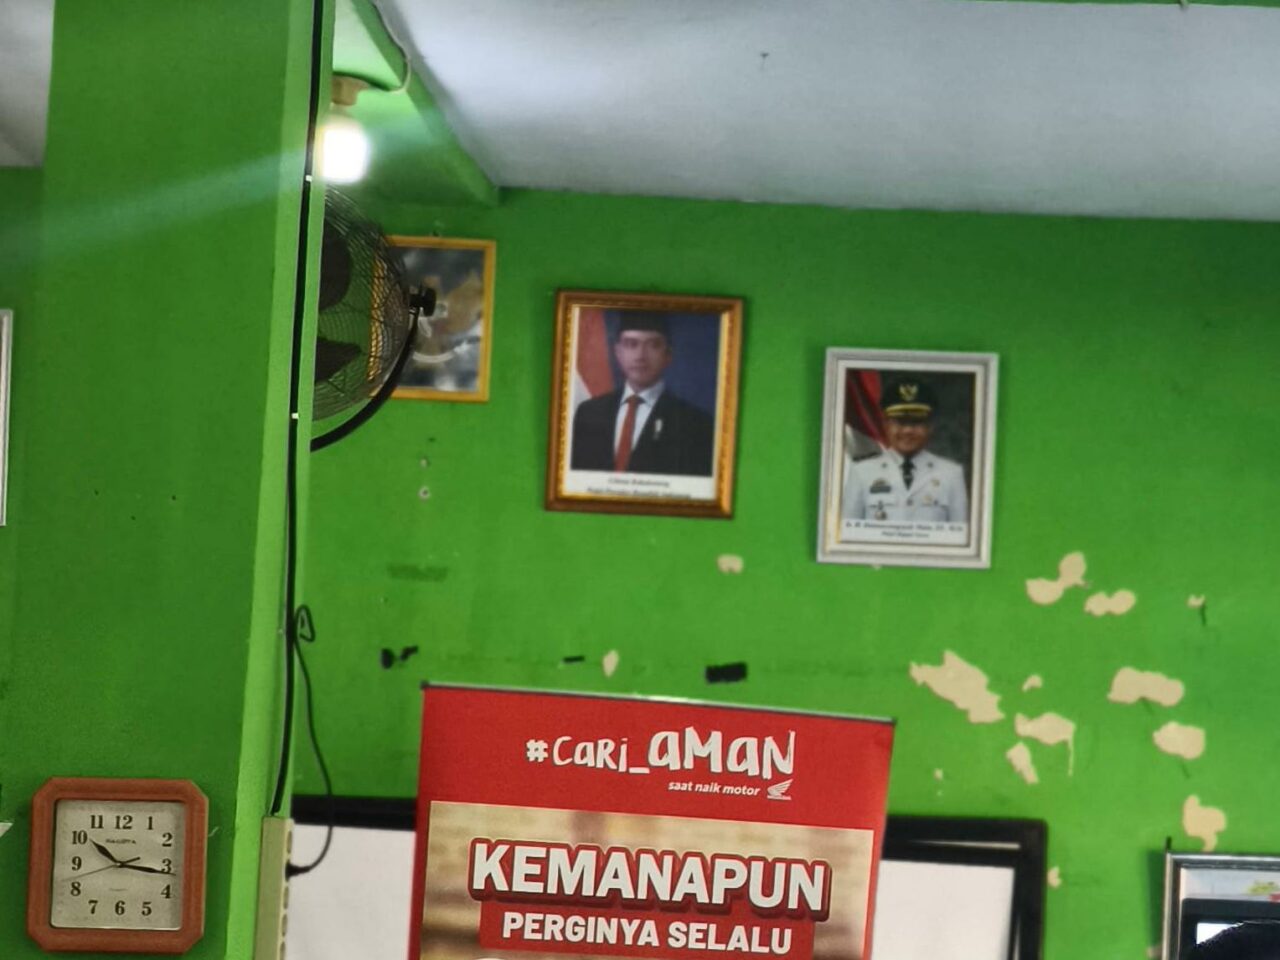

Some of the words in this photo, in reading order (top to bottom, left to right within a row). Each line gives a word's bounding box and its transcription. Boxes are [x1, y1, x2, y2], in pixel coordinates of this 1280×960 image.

[667, 781, 693, 792] saat
[694, 782, 721, 794] naik
[722, 784, 761, 796] motor
[90, 814, 104, 829] 11
[114, 814, 133, 830] 12
[147, 816, 154, 831] 1
[72, 830, 88, 845] 10
[161, 832, 173, 848] 2
[71, 856, 82, 871] 9
[161, 858, 172, 874] 3
[471, 842, 827, 911] KEMANAPUN
[70, 881, 81, 897] 8
[160, 884, 171, 899] 4
[88, 899, 98, 915] 7
[114, 900, 125, 916] 6
[141, 901, 152, 916] 5
[502, 911, 661, 948] PERGINYA
[667, 919, 793, 955] SELALU
